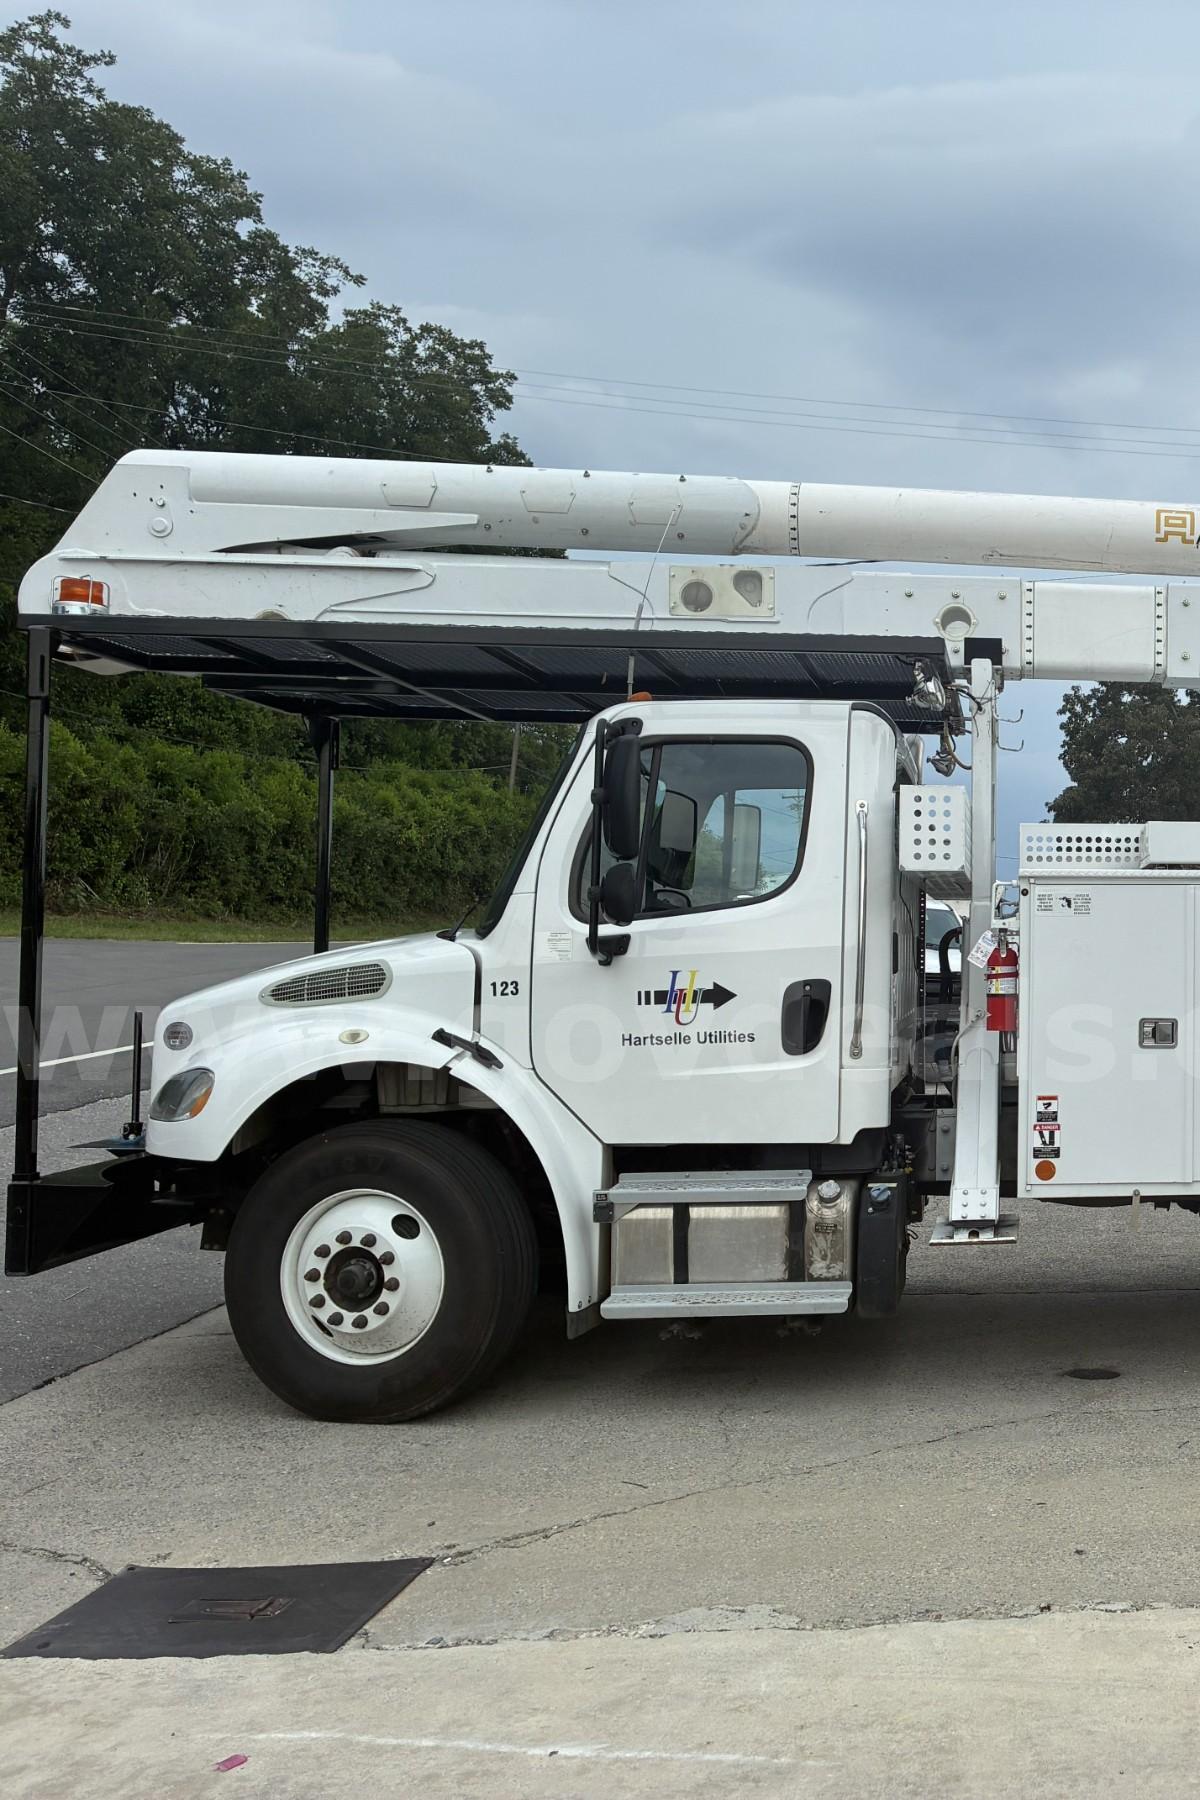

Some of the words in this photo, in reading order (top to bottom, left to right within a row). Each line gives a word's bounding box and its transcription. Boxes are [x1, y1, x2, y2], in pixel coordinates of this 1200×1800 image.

[490, 980, 519, 997] 123
[621, 1031, 691, 1046] Hartselle
[697, 1030, 756, 1044] Utilities
